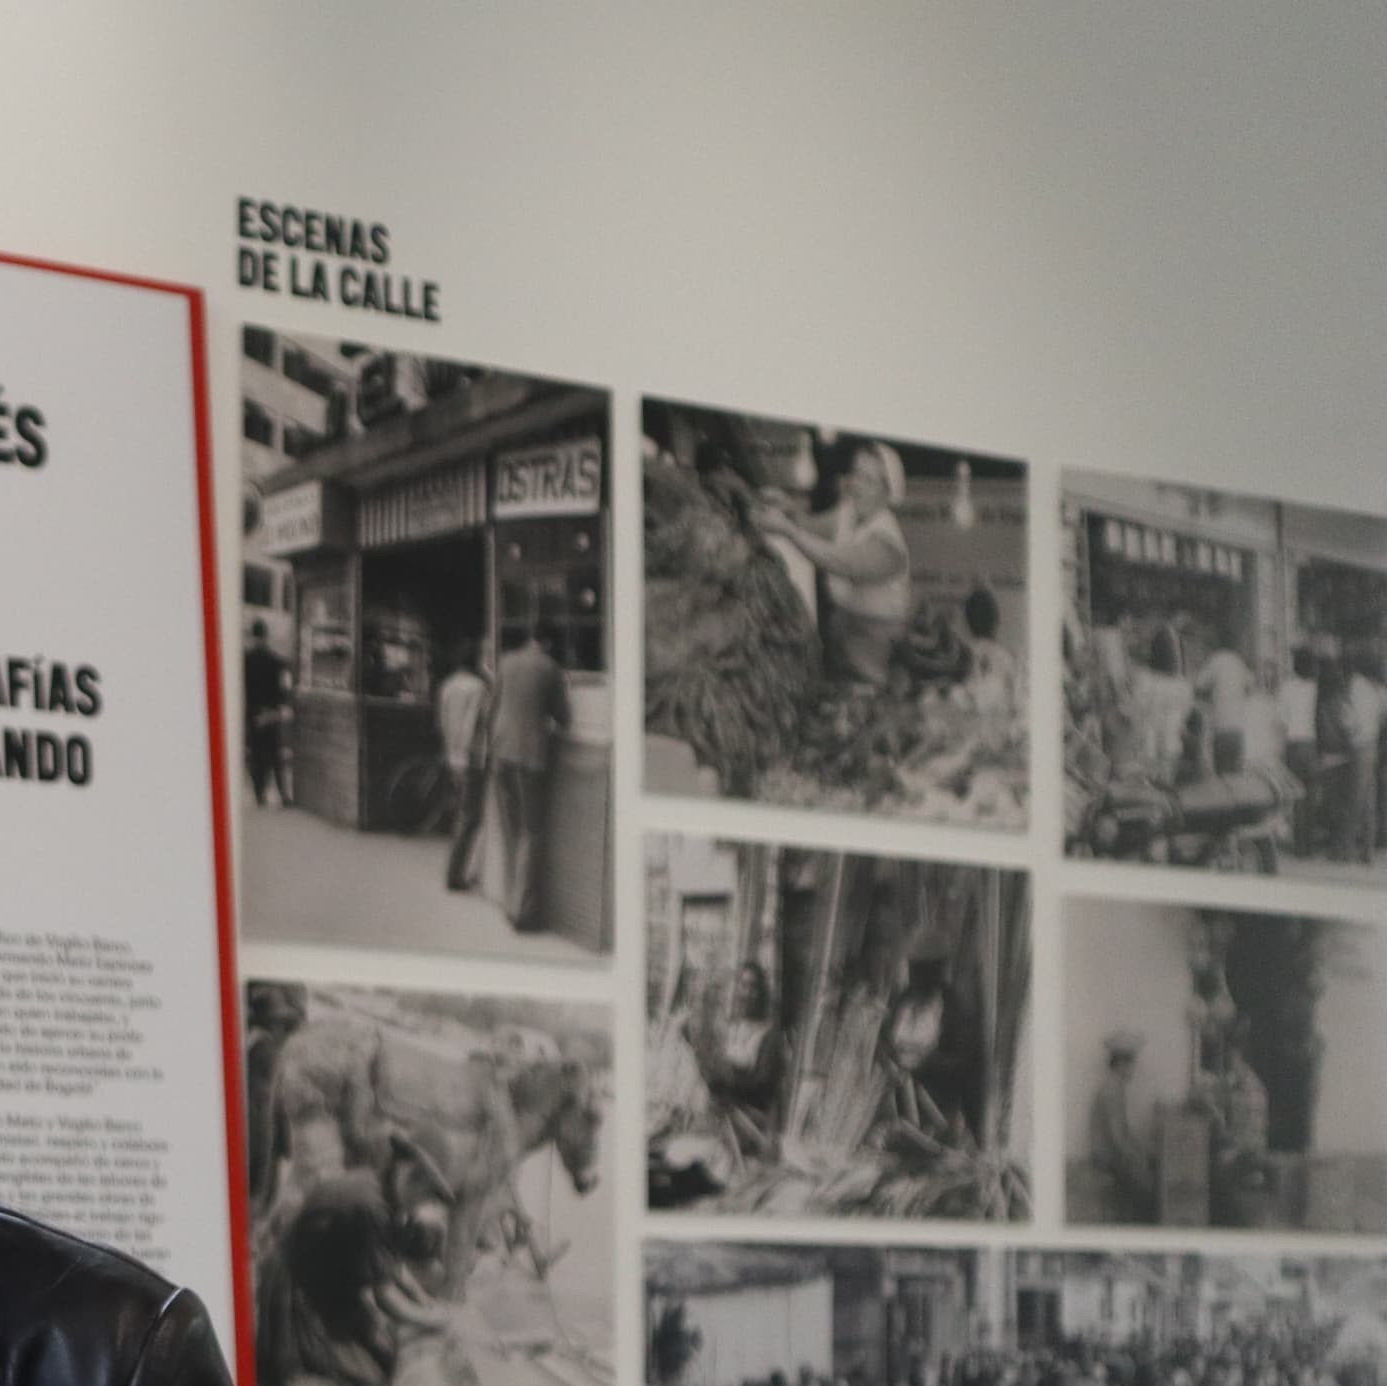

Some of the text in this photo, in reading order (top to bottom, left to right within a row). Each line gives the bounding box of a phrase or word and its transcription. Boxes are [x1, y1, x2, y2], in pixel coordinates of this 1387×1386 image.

[237, 197, 390, 264] ESCENAS
[237, 247, 442, 323] DE LA CALLE
